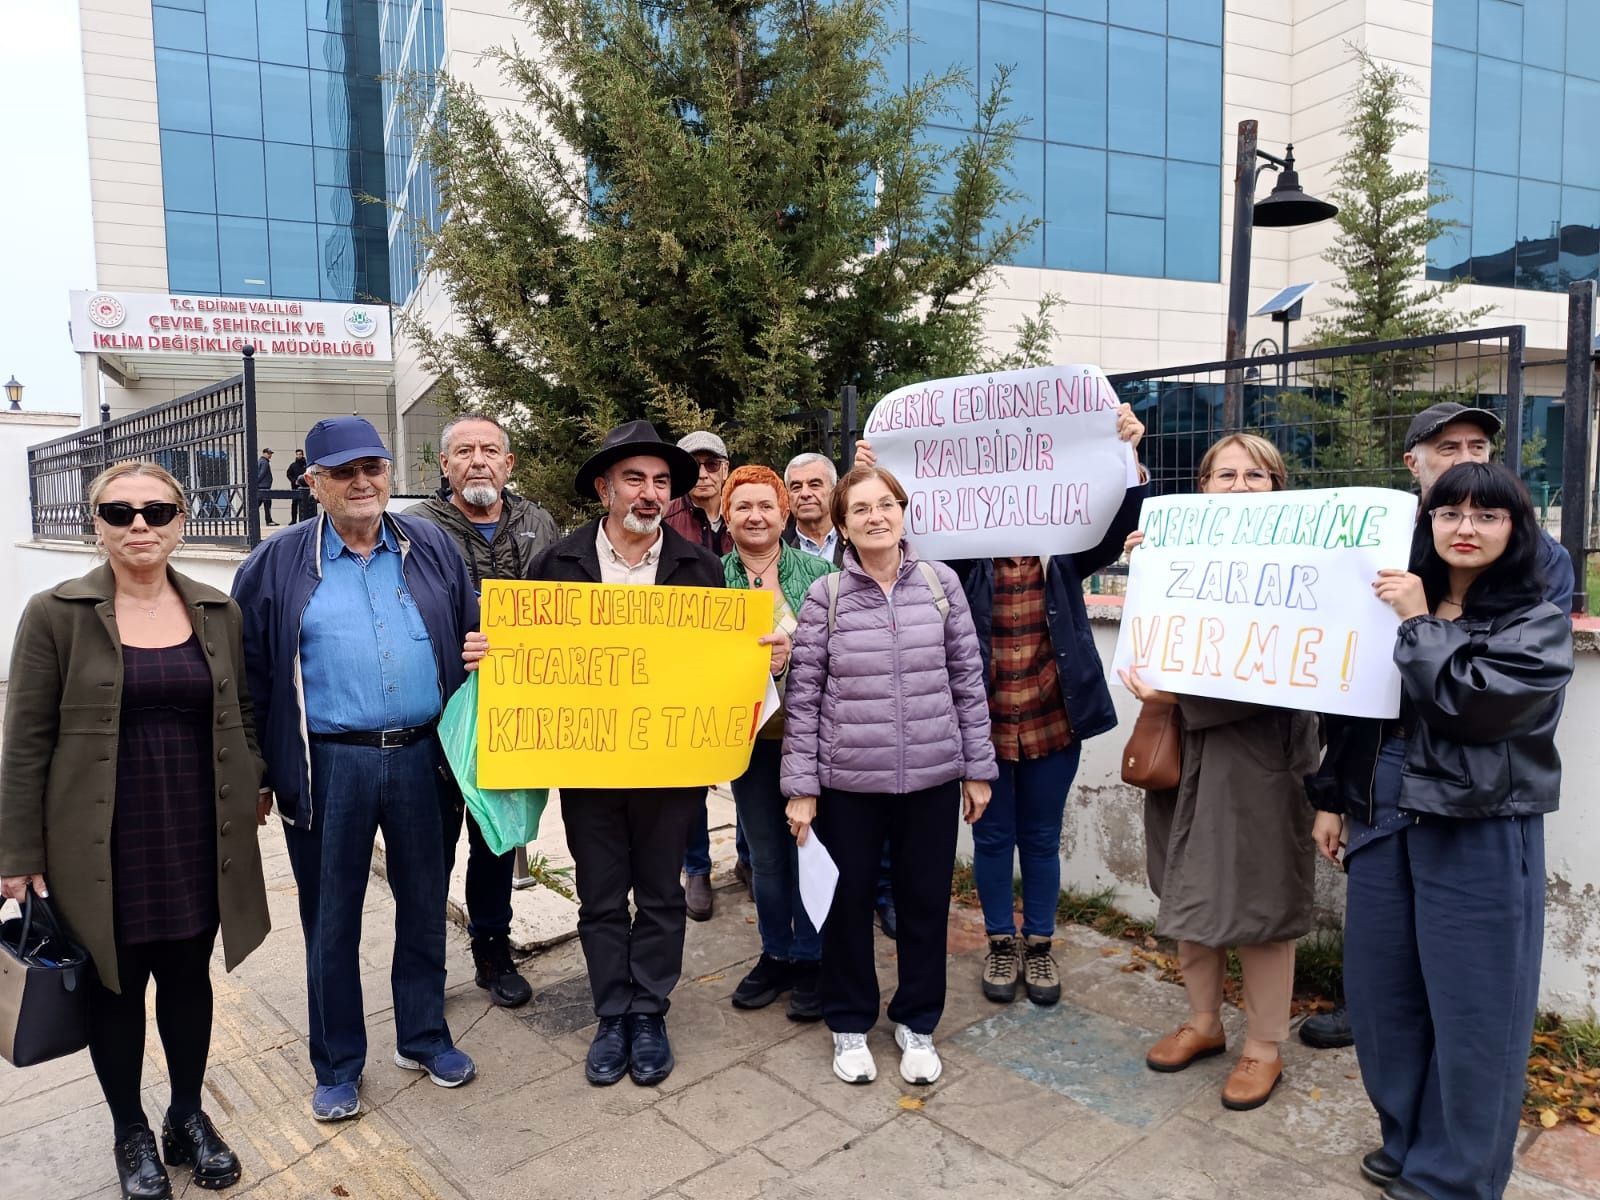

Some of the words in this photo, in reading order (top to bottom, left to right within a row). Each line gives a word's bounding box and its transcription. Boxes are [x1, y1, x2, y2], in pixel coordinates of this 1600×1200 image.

[149, 315, 208, 332] ÇEVRE,
[213, 316, 302, 335] ŞEHİRCİLİK
[305, 322, 325, 335] VE
[170, 298, 194, 311] T.C.
[198, 299, 246, 314] EDİRNE
[249, 301, 303, 315] VALİLİĞİ
[93, 332, 143, 350] İKLİM
[253, 337, 268, 353] İL
[272, 338, 376, 356] MÜDÜRLÜĞÜ
[869, 388, 946, 433] MERİÇ
[914, 427, 1054, 479] KALBİDİR
[905, 483, 1092, 535] ORUYALIM
[1232, 492, 1388, 550] NEHRİME
[487, 583, 582, 627] MERİÇ
[589, 587, 746, 631] NEHRİMİZİ
[1166, 560, 1320, 610] ZARAR
[487, 643, 649, 686] TİCARETE
[1131, 615, 1359, 692] VERME!
[488, 706, 617, 753] KURBAN
